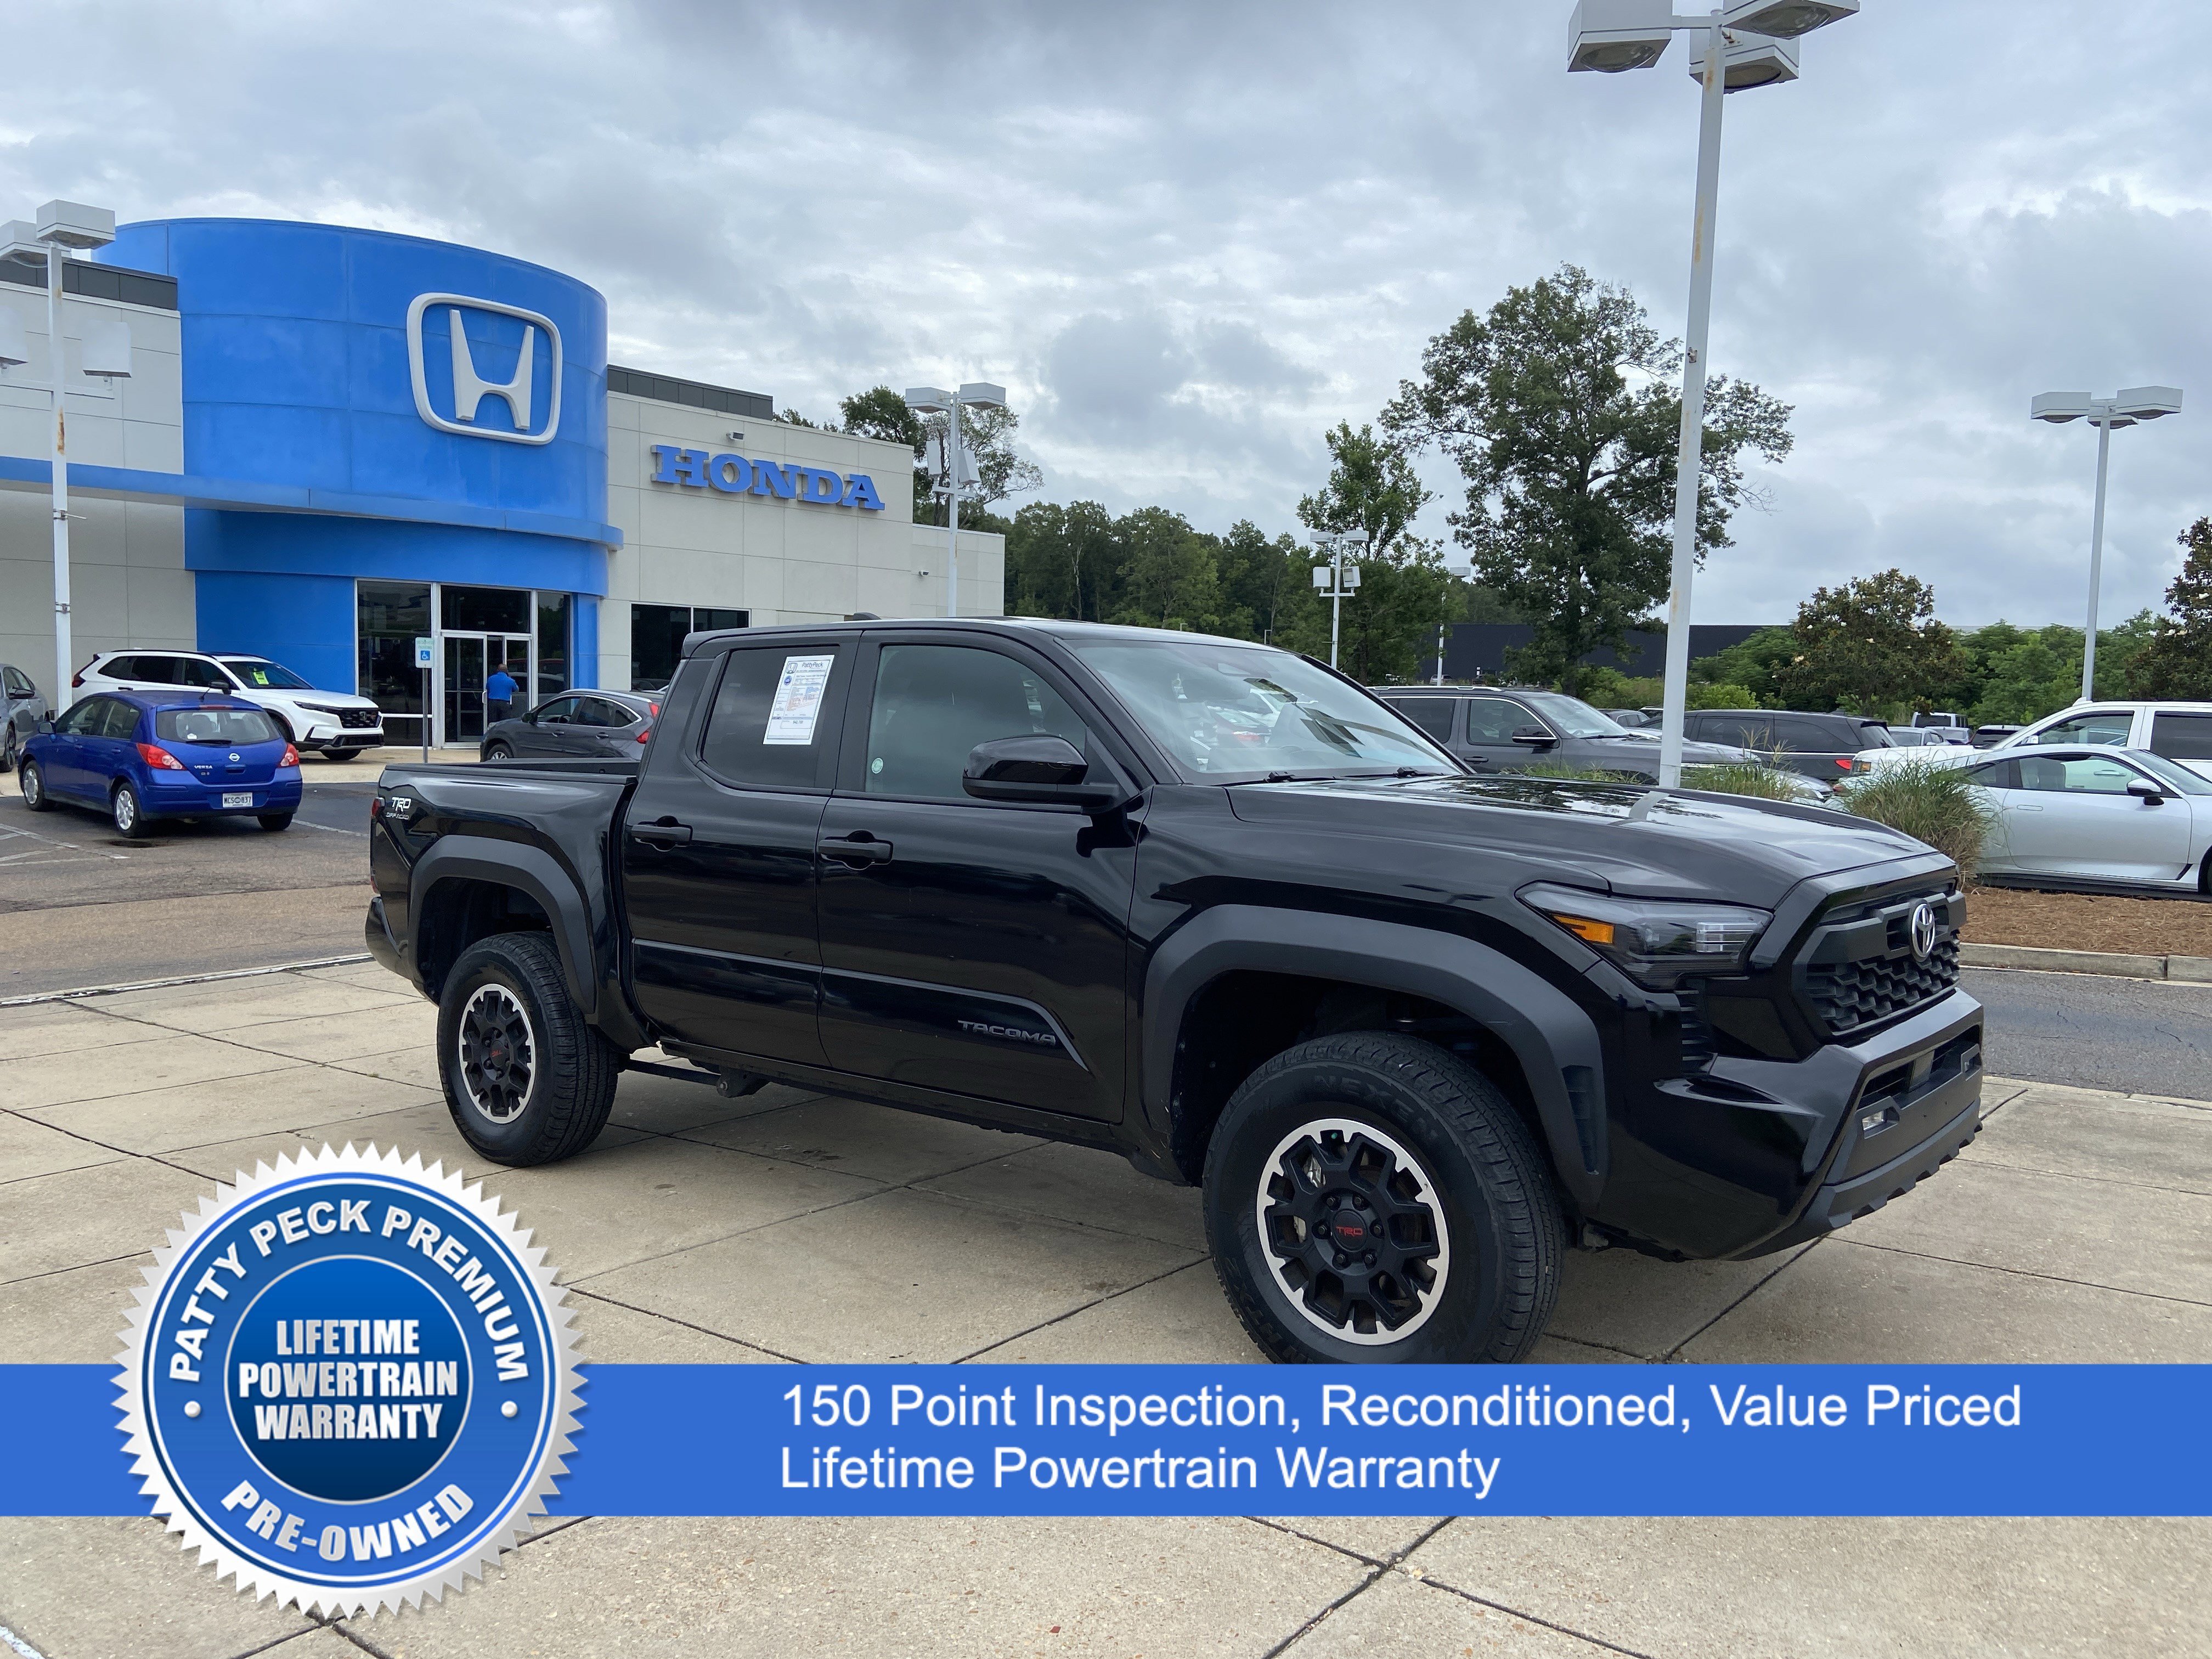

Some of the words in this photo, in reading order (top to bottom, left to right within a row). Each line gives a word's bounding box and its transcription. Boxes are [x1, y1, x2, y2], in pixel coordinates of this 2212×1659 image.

[651, 444, 885, 510] HONDA
[392, 797, 411, 812] TRD
[958, 1020, 1056, 1046] TACOMA
[1335, 1226, 1363, 1237] TRD
